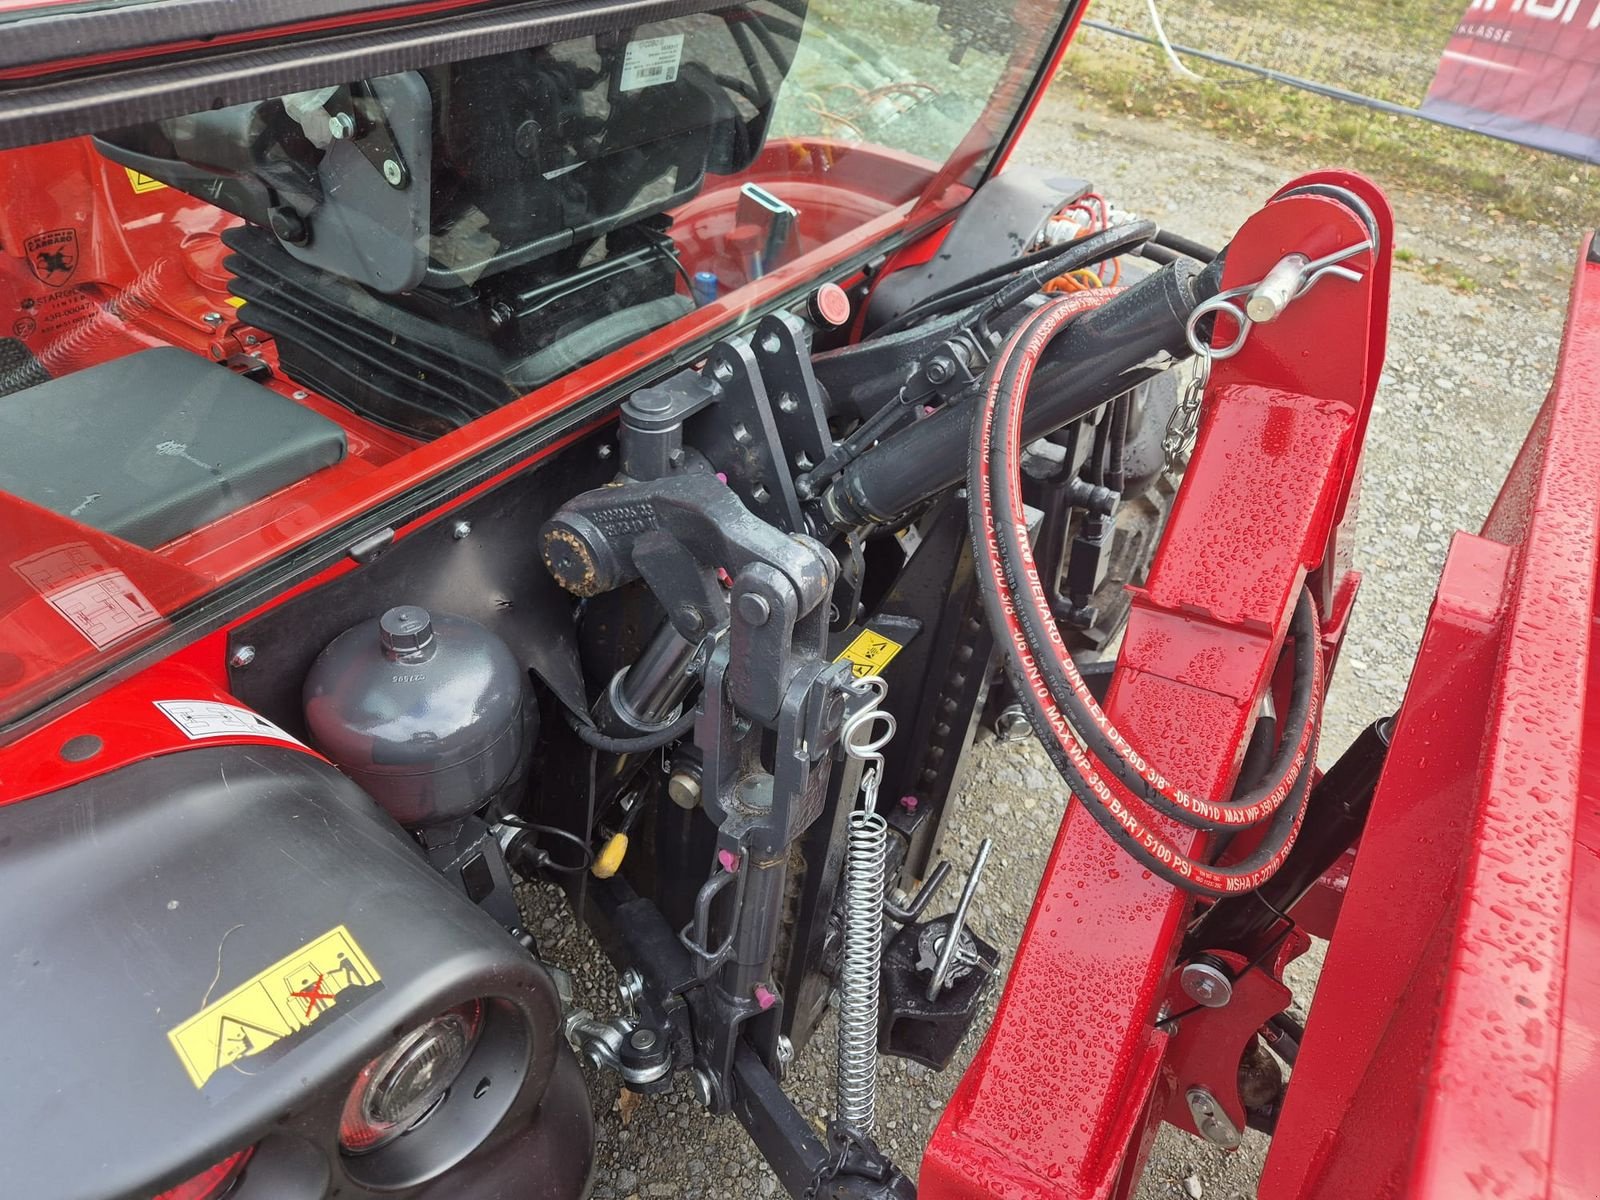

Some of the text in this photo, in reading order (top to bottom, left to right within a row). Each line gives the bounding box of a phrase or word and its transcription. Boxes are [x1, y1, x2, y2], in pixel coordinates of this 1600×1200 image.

[1022, 655, 1048, 698] DN10
[1046, 706, 1073, 743] MAX
[1071, 744, 1091, 772] WP
[1088, 771, 1111, 800] 350
[1108, 798, 1138, 833] BAR
[1143, 834, 1173, 864] 5100
[1172, 855, 1192, 878] PSI
[1062, 657, 1108, 729] DINFLEX
[1107, 726, 1147, 772] DF26D
[1173, 790, 1190, 808] -06
[1191, 798, 1220, 820] DN10
[1224, 807, 1246, 823] MAX
[1245, 806, 1261, 822] WP
[1260, 799, 1273, 818] 350
[1271, 788, 1288, 809] BAR
[1226, 876, 1251, 891] MSHA
